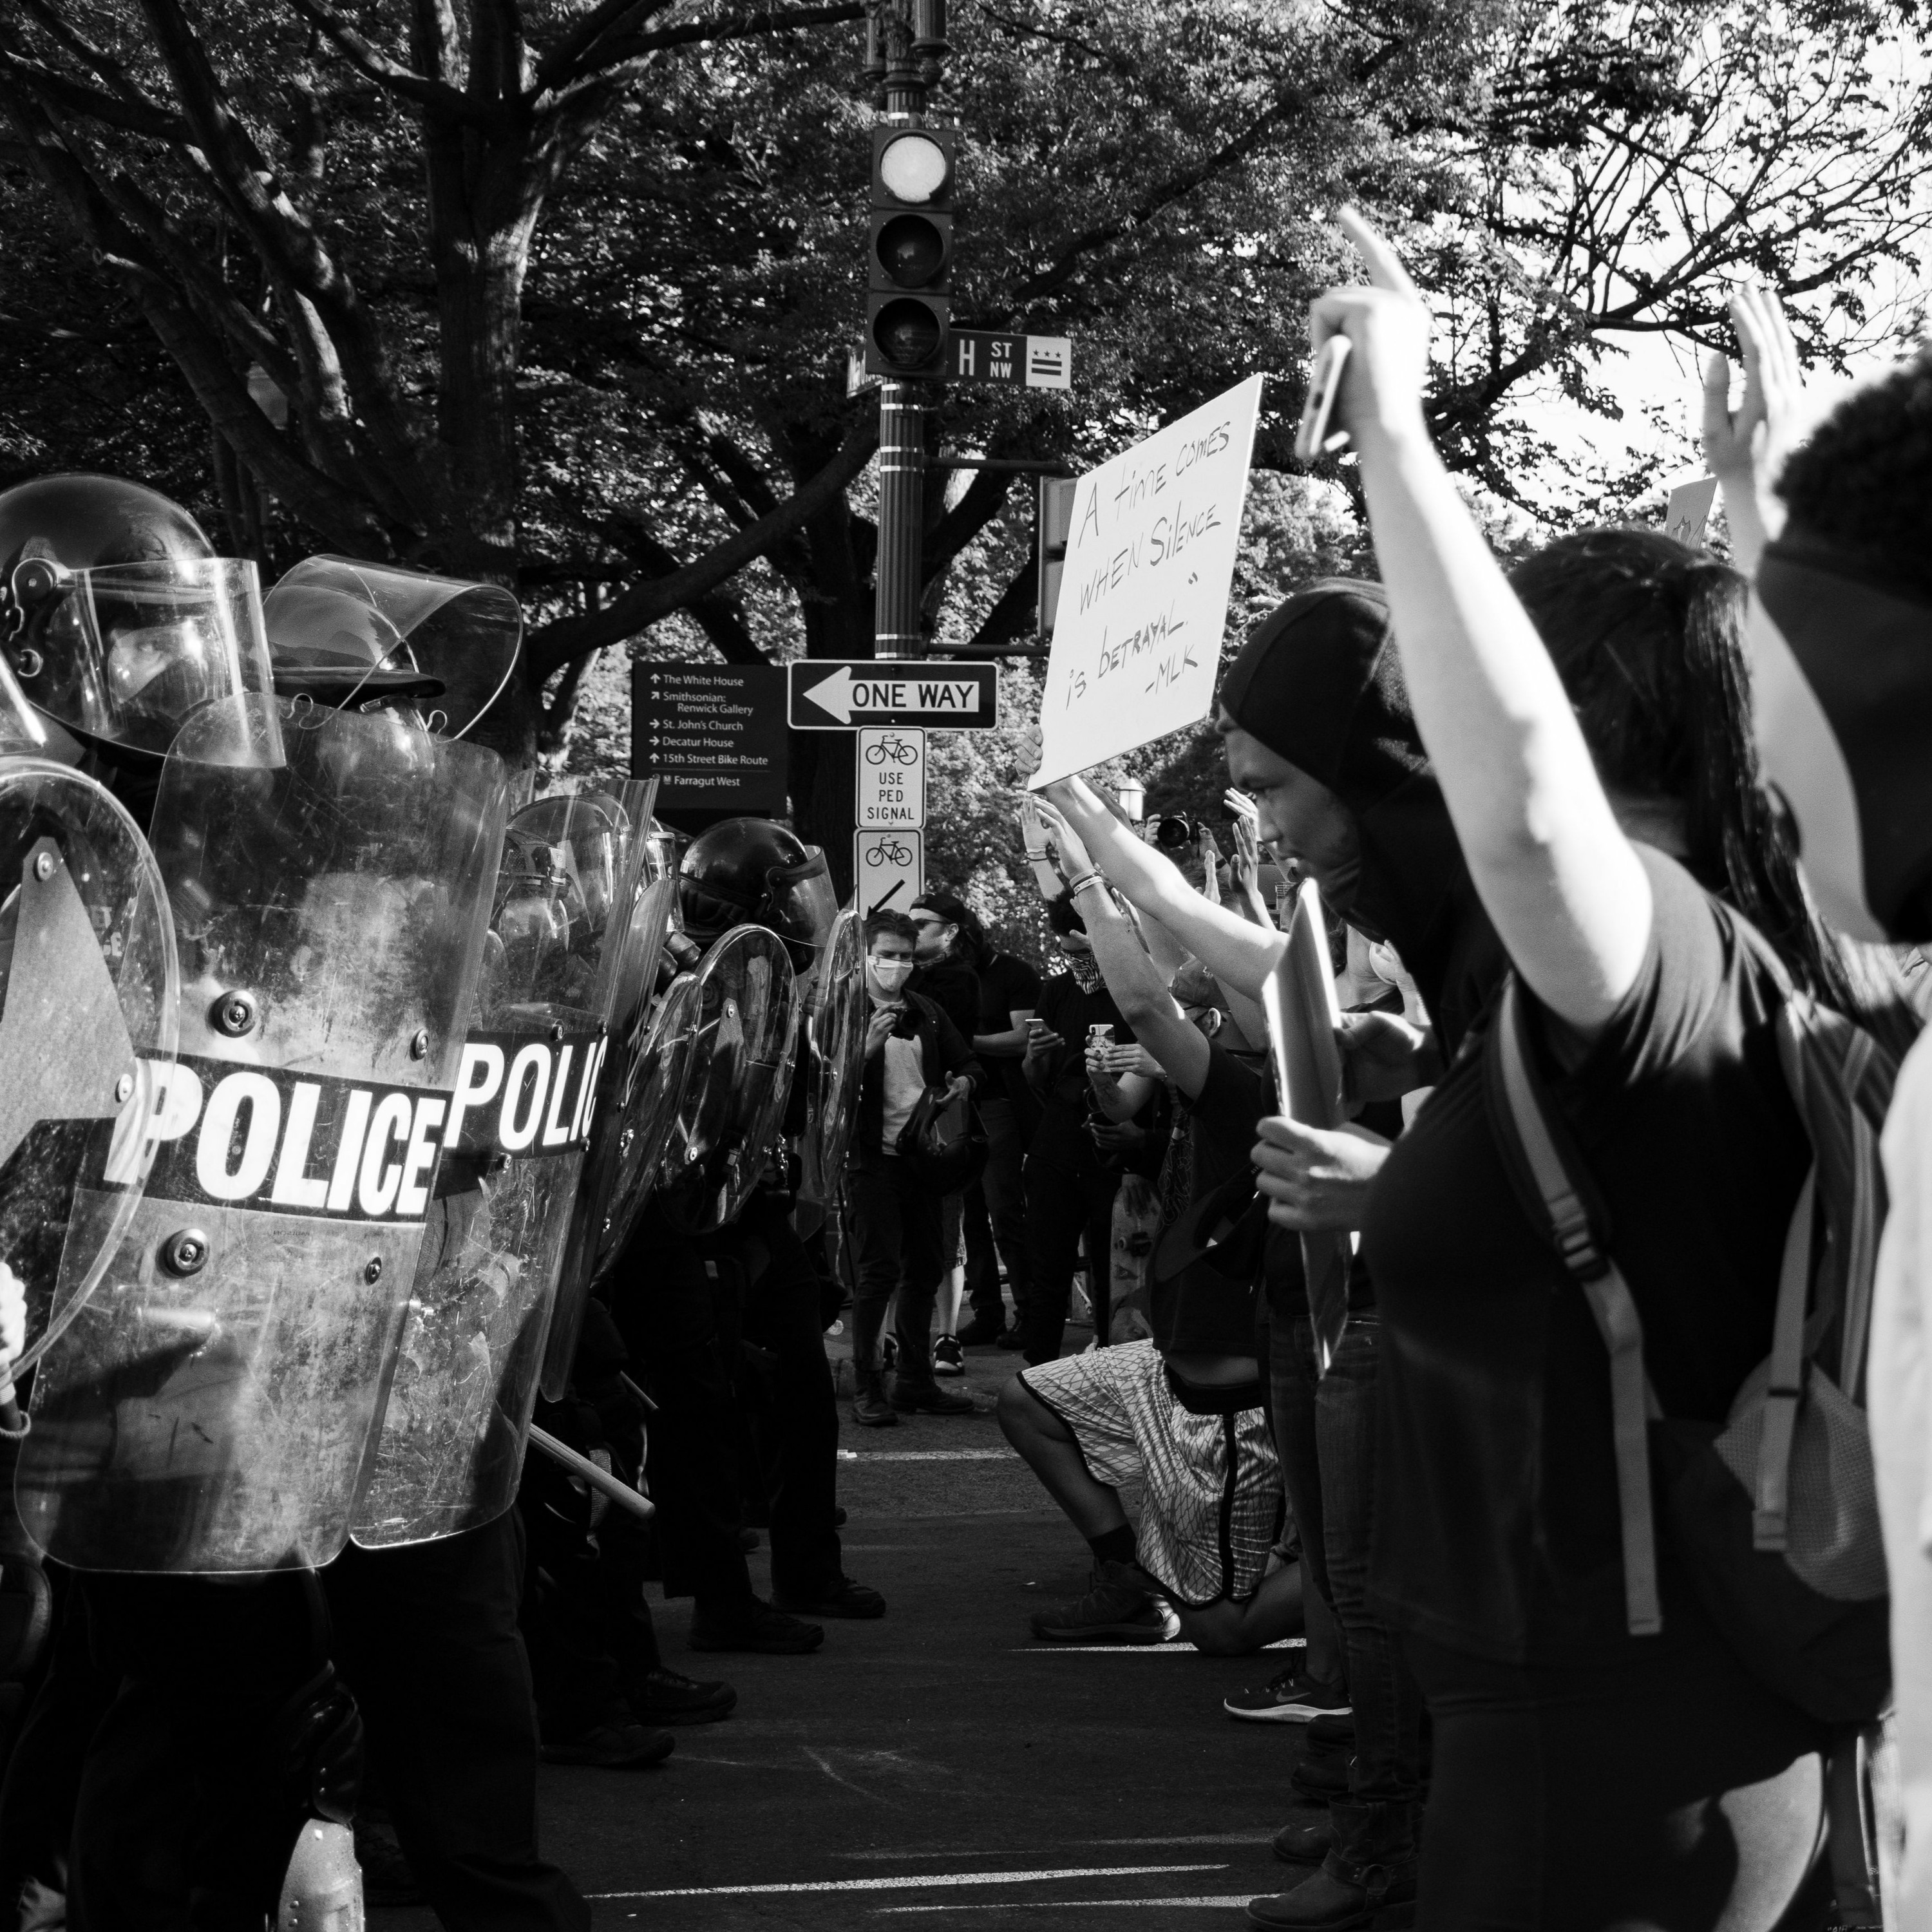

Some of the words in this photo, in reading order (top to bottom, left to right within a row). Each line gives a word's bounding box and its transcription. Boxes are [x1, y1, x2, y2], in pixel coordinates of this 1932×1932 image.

[990, 341, 1012, 358] ST
[959, 339, 975, 376] H
[990, 361, 1012, 379] NW
[1078, 482, 1099, 548] A
[663, 674, 681, 685] The
[683, 675, 712, 685] White
[714, 676, 744, 687] House
[663, 691, 726, 703] Smithsonian:
[853, 683, 907, 708] ONE
[918, 684, 974, 708] WAY
[677, 703, 717, 713] Renwick
[719, 704, 753, 716] Gallery
[663, 719, 675, 729] St.
[677, 719, 706, 730] John's
[708, 720, 743, 731] Church
[663, 736, 701, 747] Decatur
[703, 737, 734, 748] House
[663, 753, 685, 763] 15th
[687, 753, 716, 764] Street
[717, 754, 739, 764] Bike
[740, 755, 768, 765] Route
[674, 775, 715, 788] Farragut
[716, 777, 740, 786] West
[879, 772, 904, 785] USE
[879, 790, 904, 802] PED
[867, 807, 914, 820] SIGNAL
[443, 1036, 608, 1150] POLIC
[103, 1057, 446, 1216] POLICE
